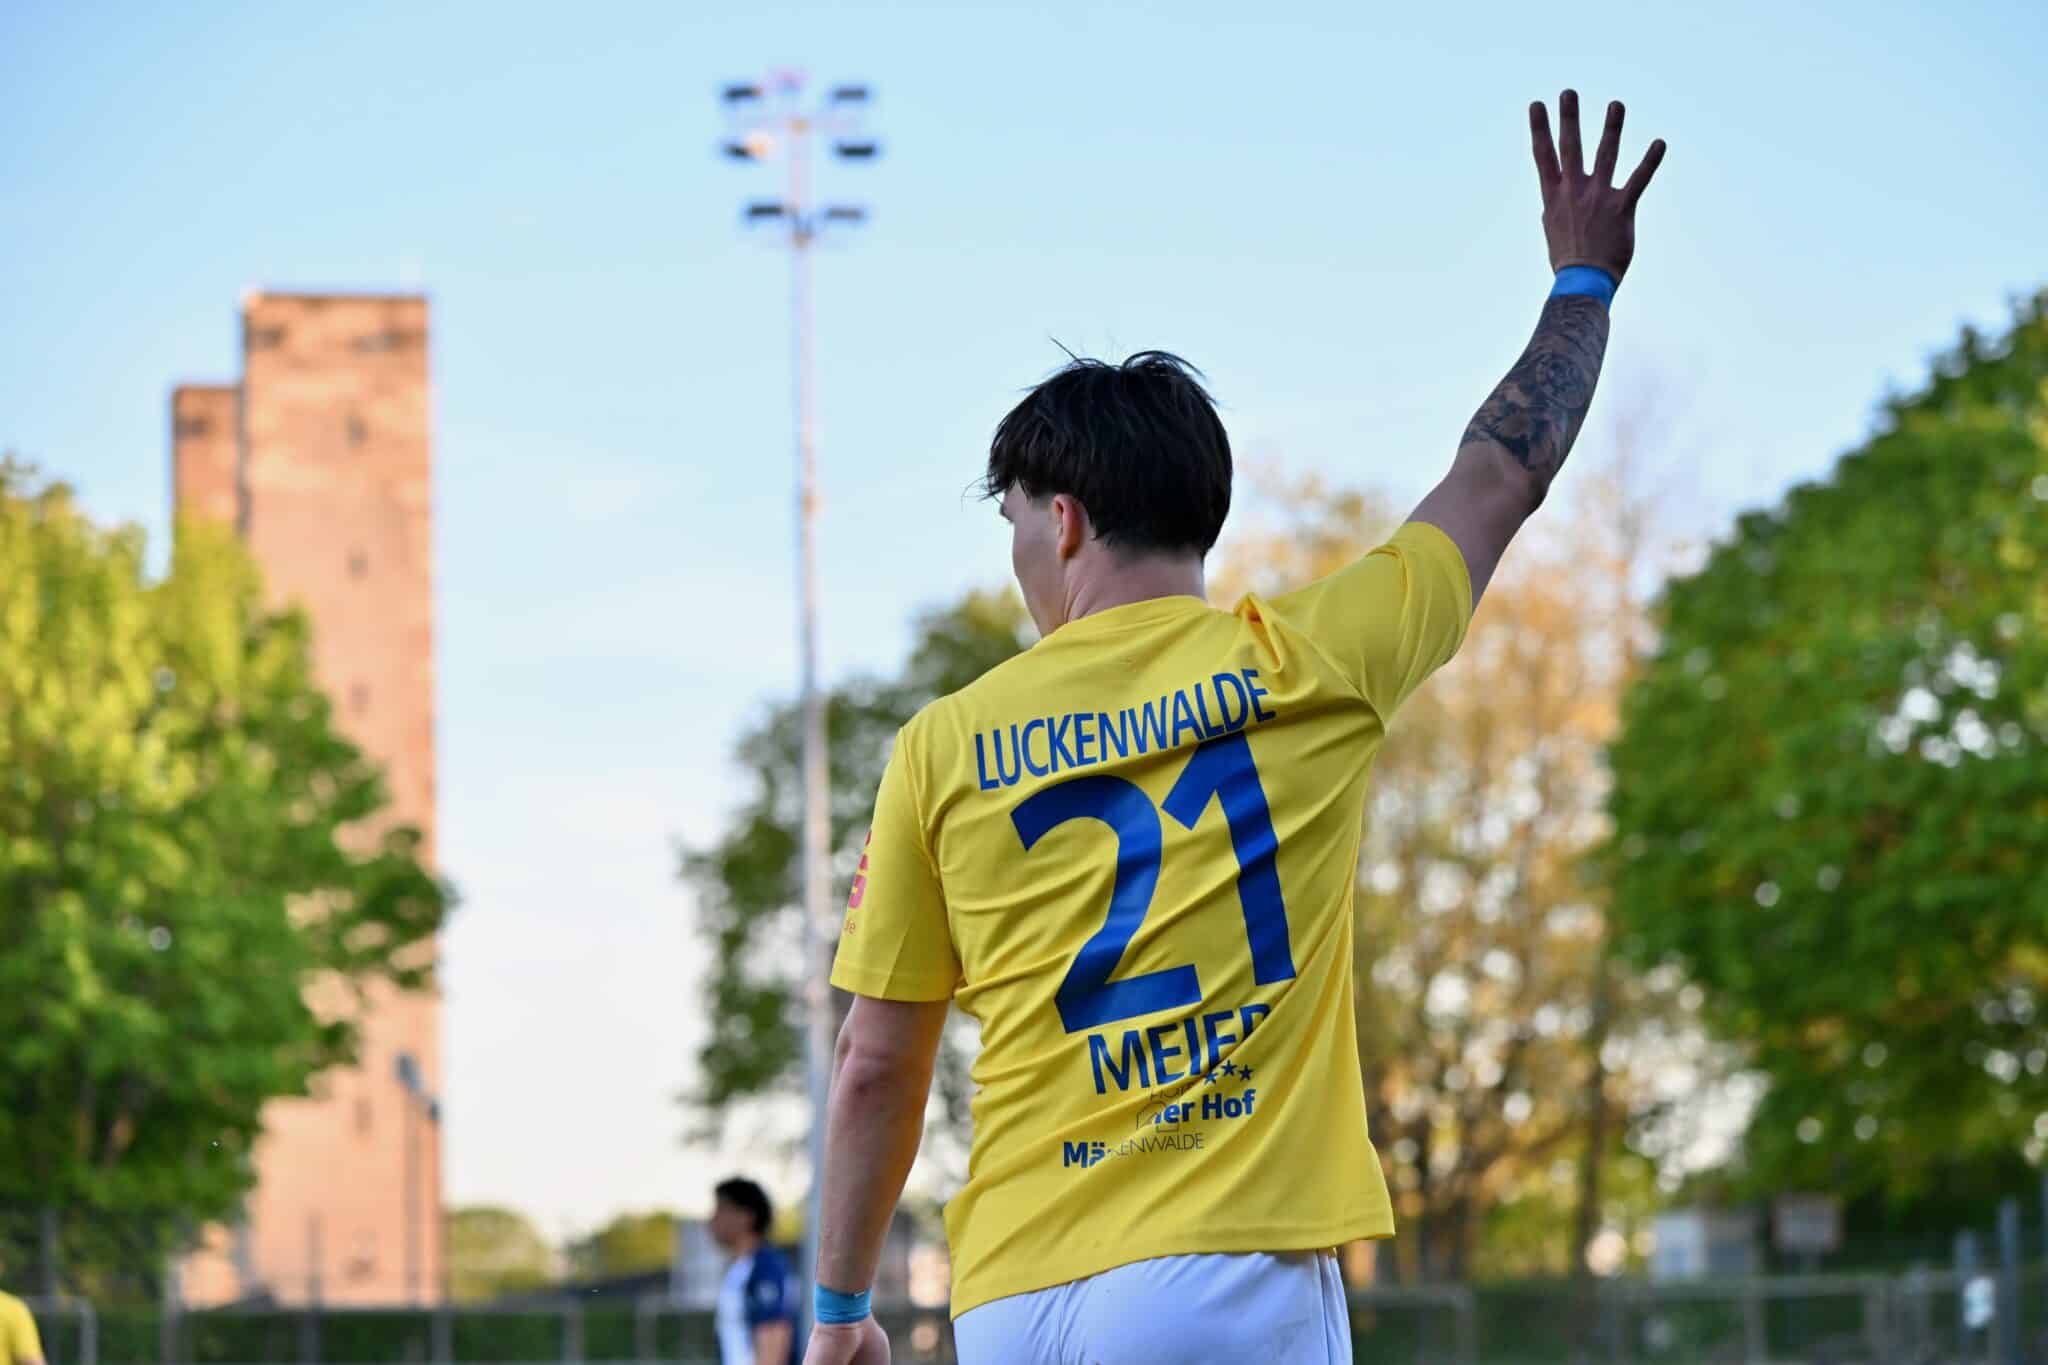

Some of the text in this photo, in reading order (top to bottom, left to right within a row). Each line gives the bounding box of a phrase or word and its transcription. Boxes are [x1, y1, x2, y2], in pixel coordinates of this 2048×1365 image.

[975, 668, 1277, 790] LUCKENWALDE
[1010, 730, 1297, 1034] 21
[1202, 1088, 1256, 1120] Hof
